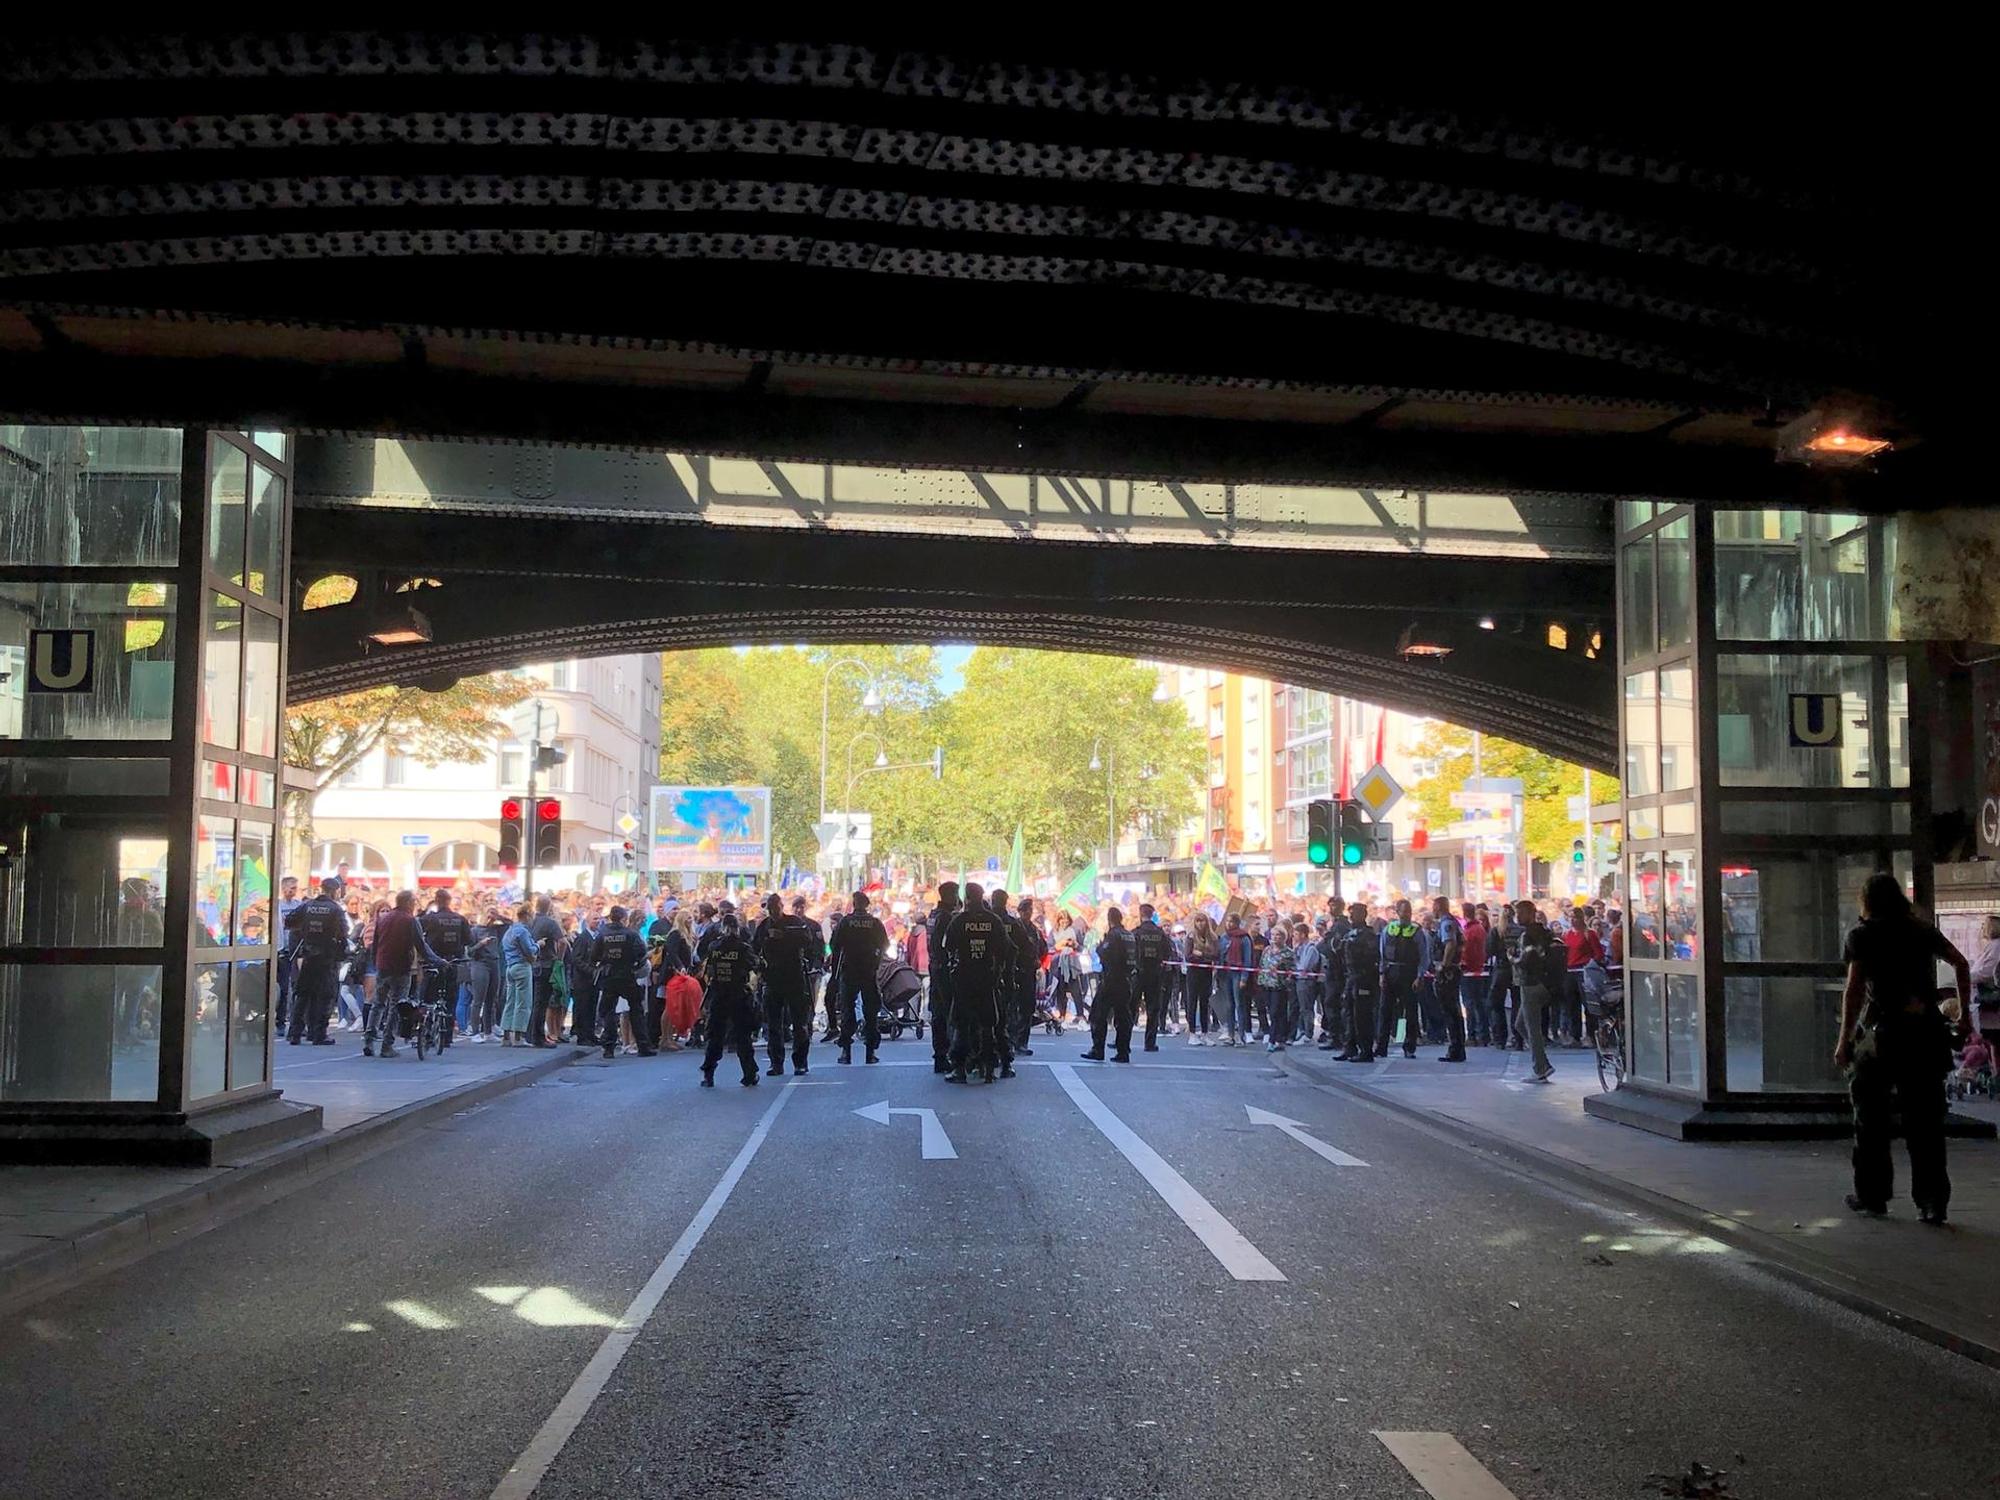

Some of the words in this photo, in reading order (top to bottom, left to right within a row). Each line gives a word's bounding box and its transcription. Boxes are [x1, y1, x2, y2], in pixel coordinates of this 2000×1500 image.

[36, 634, 90, 689] U
[1793, 697, 1838, 744] U
[849, 919, 874, 928] POLIZEI
[965, 922, 992, 932] POLIZEI
[603, 935, 626, 943] POLIZEI
[1140, 934, 1162, 942] POLIZEI
